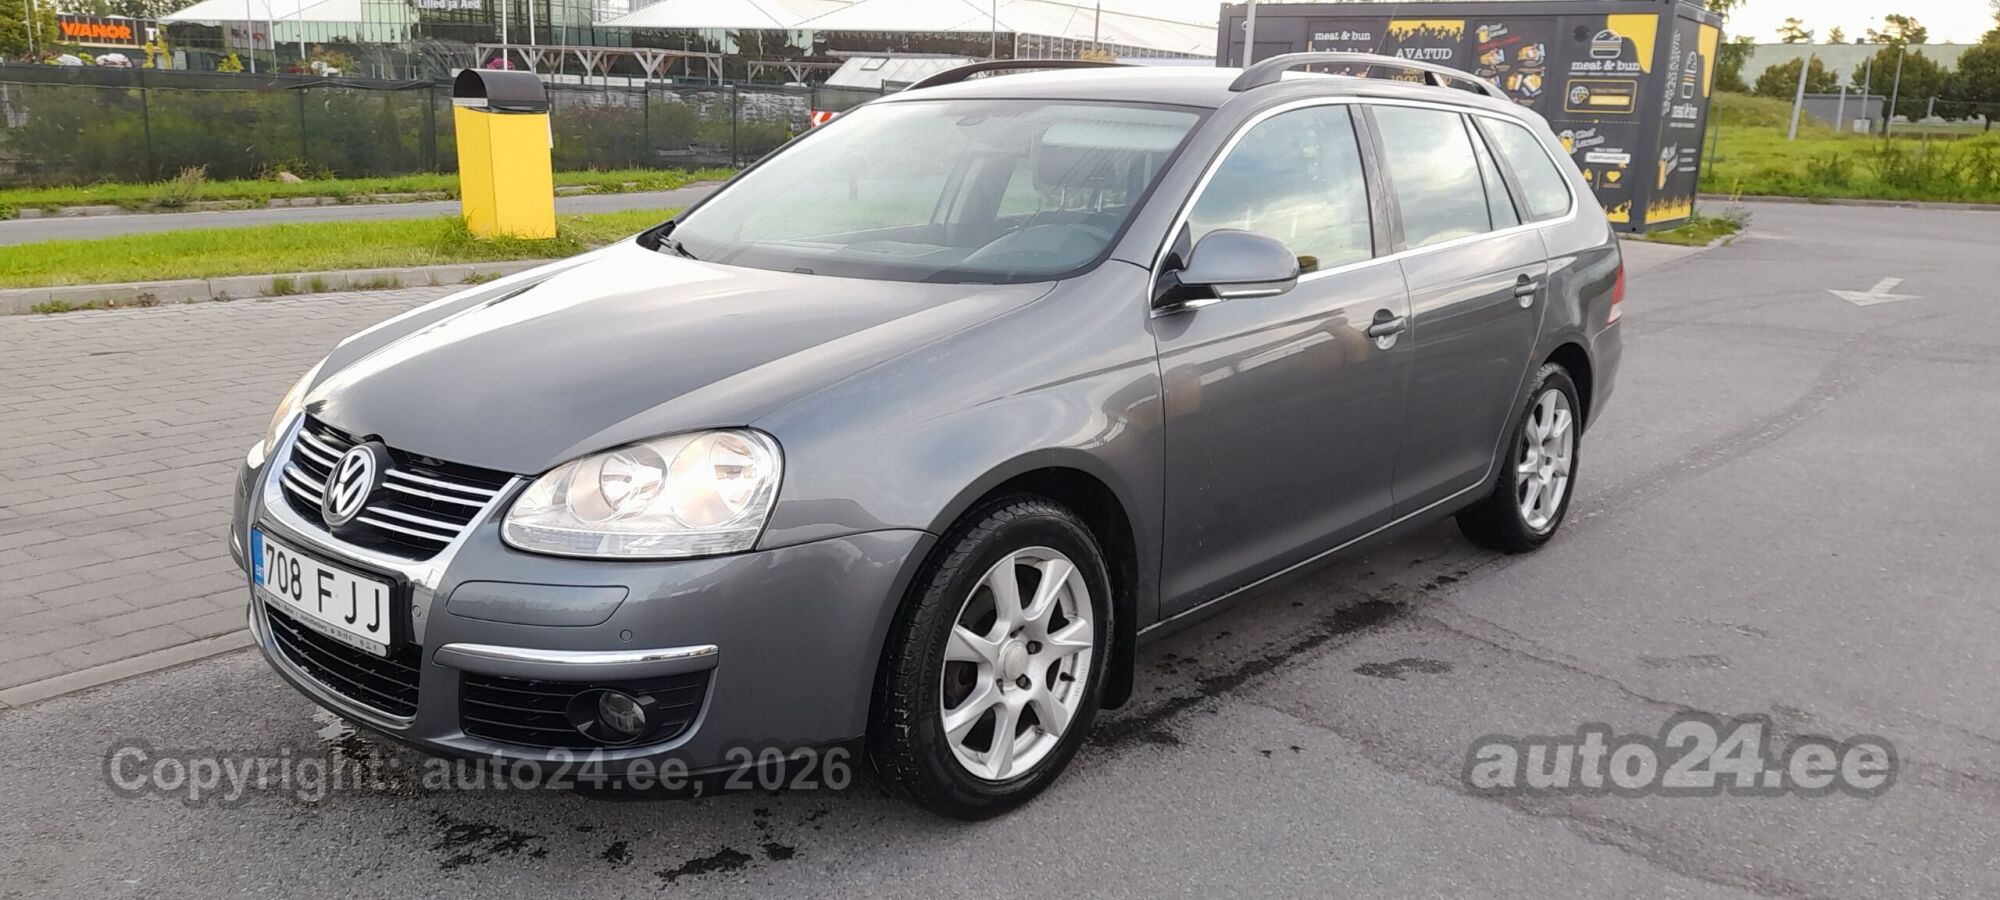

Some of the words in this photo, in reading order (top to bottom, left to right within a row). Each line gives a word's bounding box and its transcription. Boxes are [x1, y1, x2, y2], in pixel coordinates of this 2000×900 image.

[418, 0, 445, 8] Lilled
[447, 0, 458, 11] ja
[460, 0, 480, 8] Aed
[61, 22, 132, 39] VIANOR
[1314, 31, 1341, 41] meat
[1341, 31, 1350, 41] &
[1351, 31, 1371, 41] bun
[1395, 47, 1453, 60] AVATUD
[1571, 61, 1602, 71] meat
[1604, 60, 1615, 70] &
[1617, 61, 1640, 71] bun
[266, 542, 302, 602] 708
[317, 567, 380, 633] FJJ
